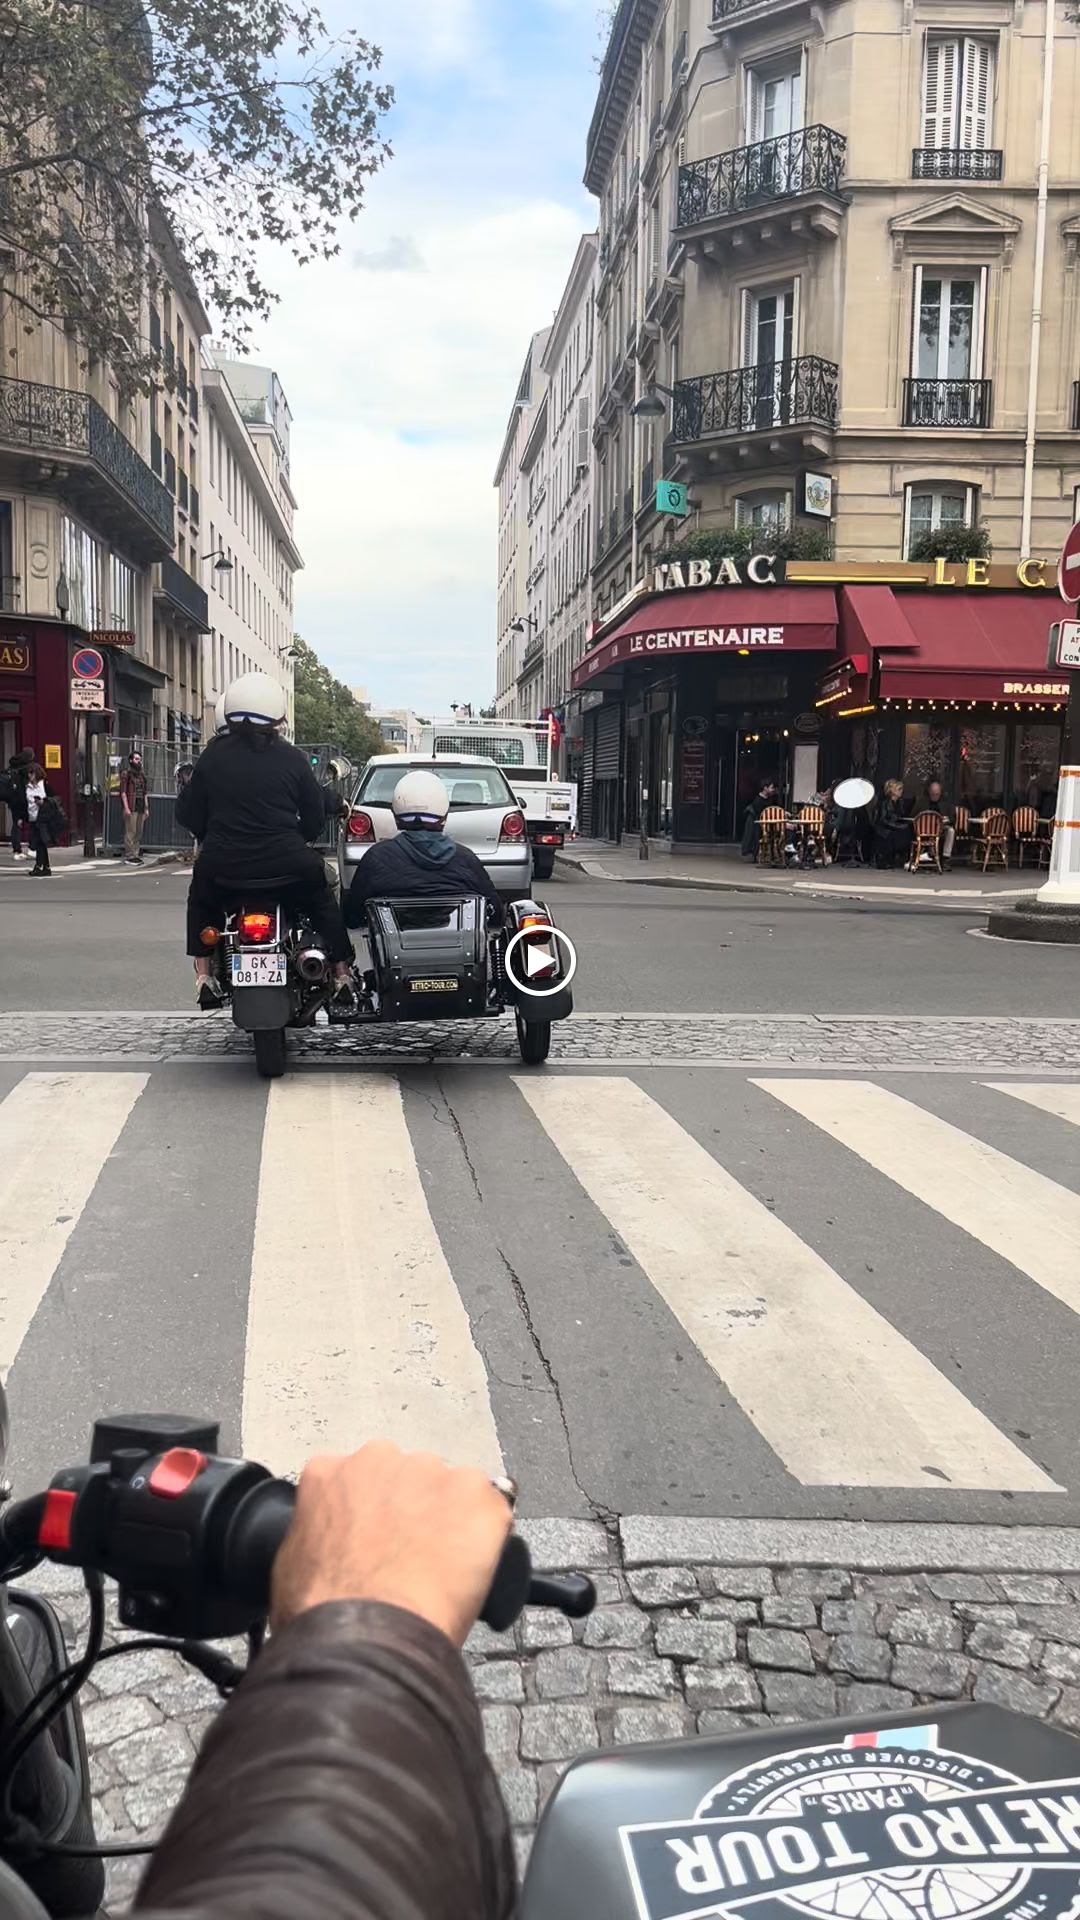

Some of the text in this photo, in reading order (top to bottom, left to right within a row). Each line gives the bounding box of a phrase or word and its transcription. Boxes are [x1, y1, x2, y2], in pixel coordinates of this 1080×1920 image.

[652, 554, 777, 592] TABAC
[934, 556, 1060, 588] LE C
[92, 631, 132, 641] NICOLAS
[630, 636, 643, 652] LE
[646, 626, 784, 650] CENTENAIRE
[1003, 682, 1070, 695] BRASSER
[237, 970, 283, 983] 081-ZA
[731, 1752, 973, 1805] DISCOVER DIFFERENTLY
[821, 1786, 905, 1815] PARIS
[664, 1821, 870, 1894] TOUR
